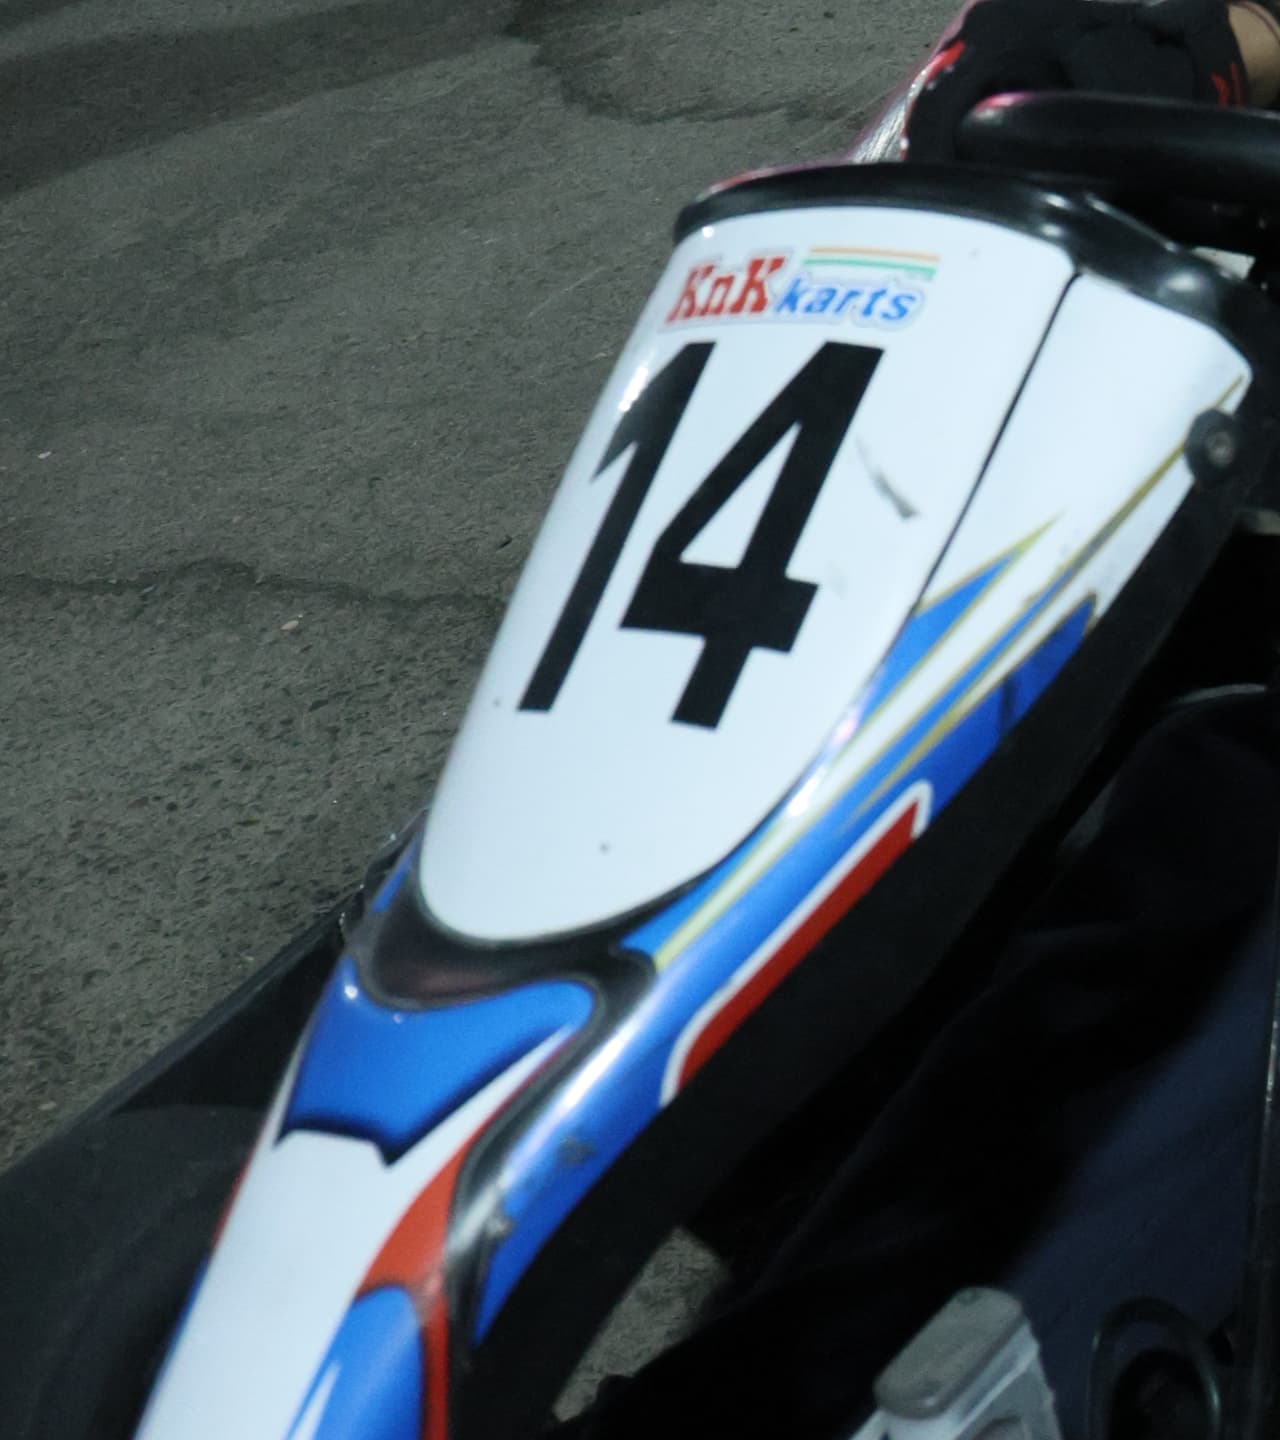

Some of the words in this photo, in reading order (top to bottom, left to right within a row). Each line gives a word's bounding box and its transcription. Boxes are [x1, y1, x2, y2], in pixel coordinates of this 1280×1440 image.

[665, 256, 786, 324] KnK
[775, 277, 917, 322] karts
[517, 340, 885, 730] 14
